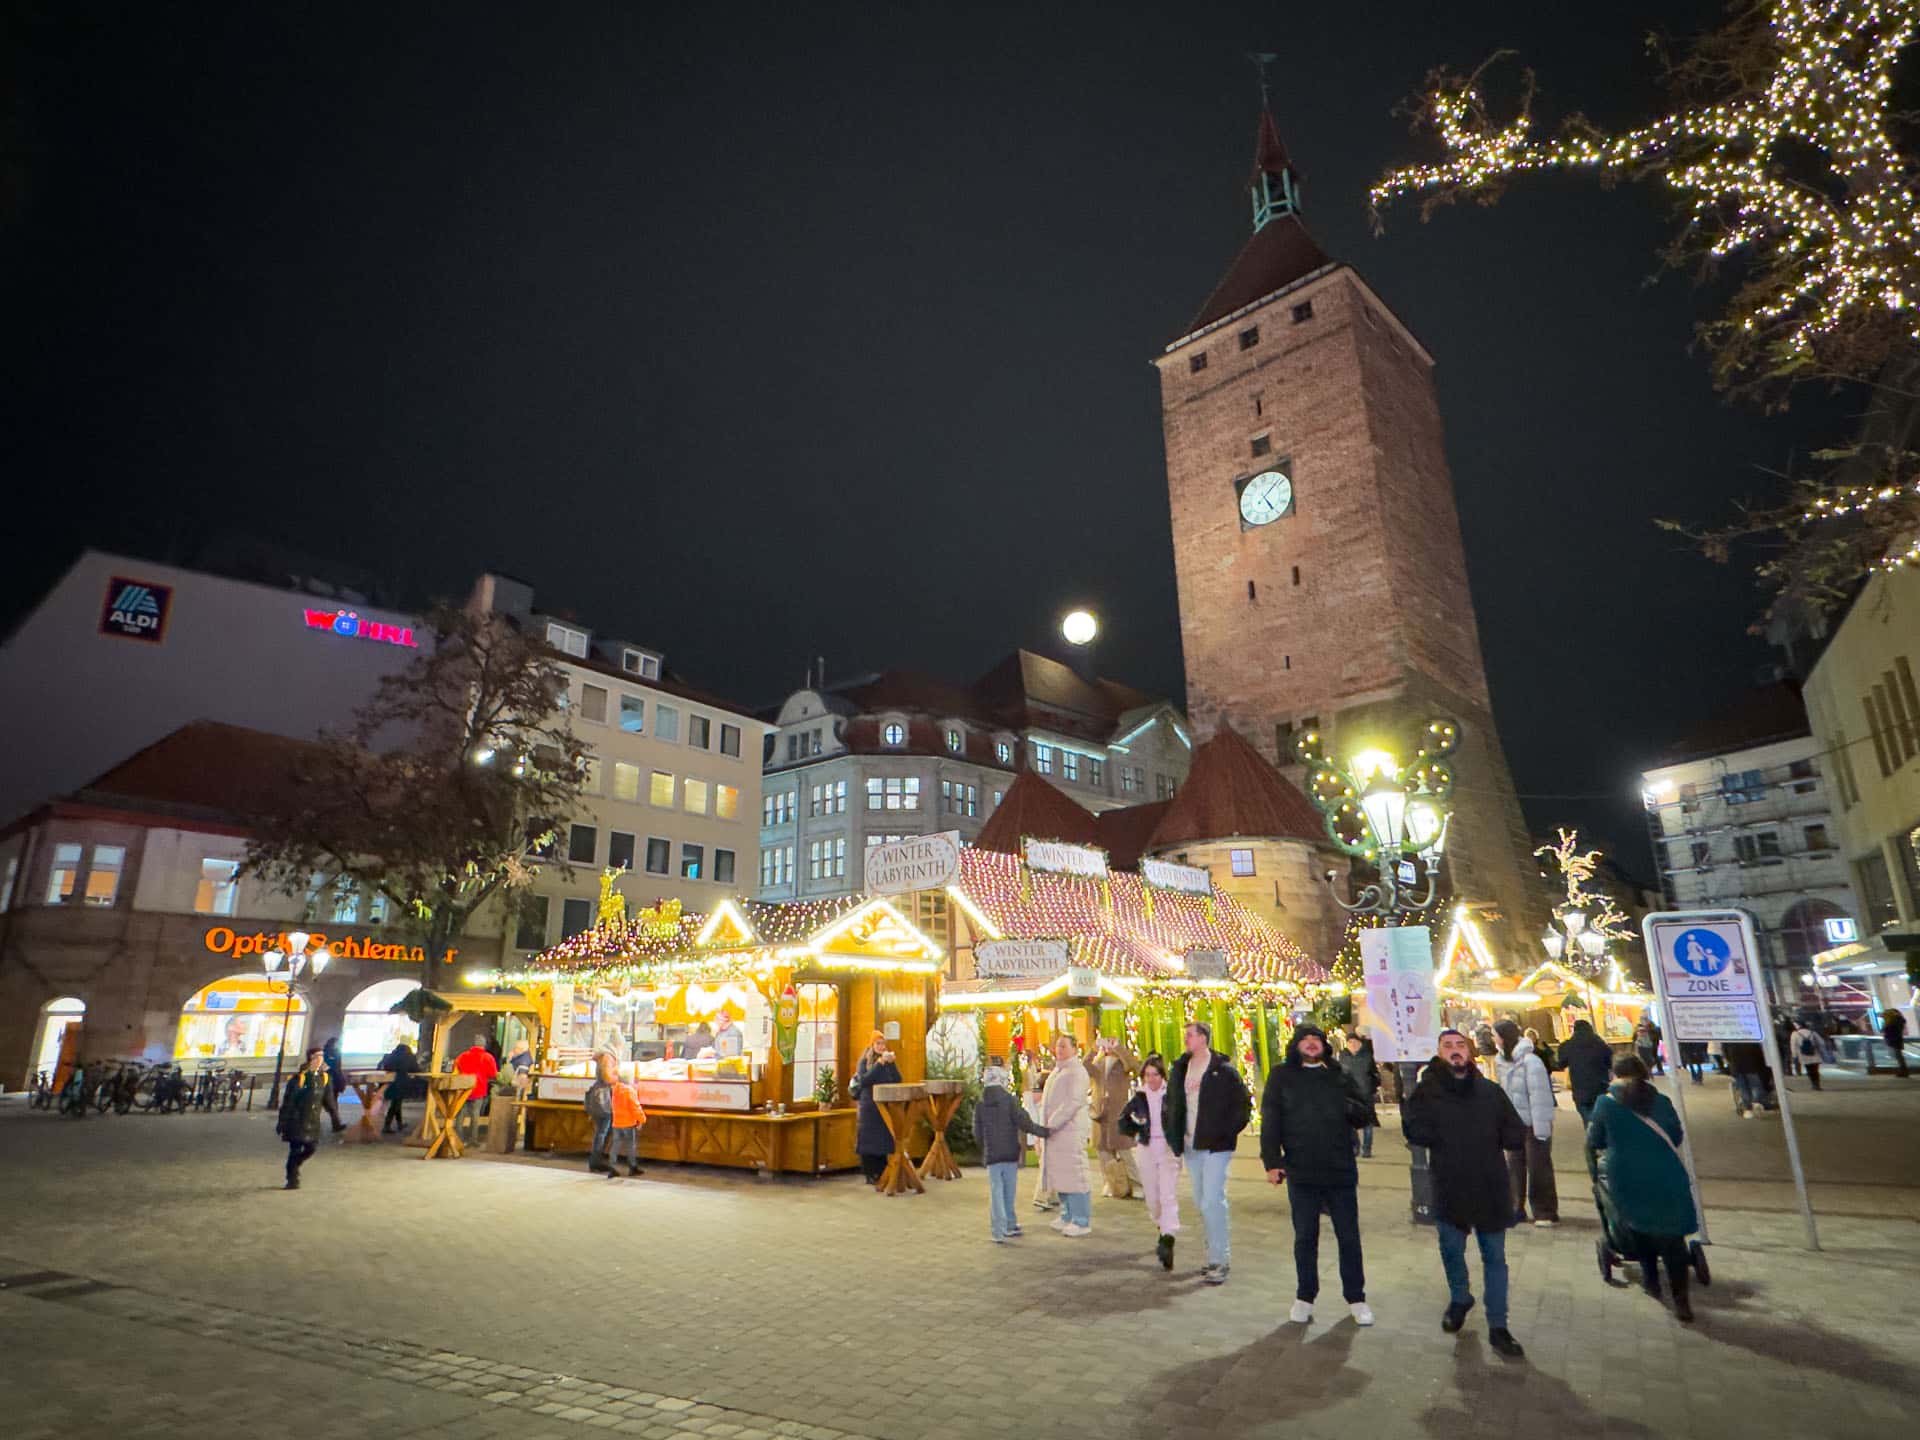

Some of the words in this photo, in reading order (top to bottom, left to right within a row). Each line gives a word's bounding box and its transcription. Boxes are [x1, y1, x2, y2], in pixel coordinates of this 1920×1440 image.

[110, 611, 158, 629] ALDI
[304, 608, 418, 647] WÖHRL
[875, 860, 945, 885] LABYRINTH
[1831, 920, 1853, 939] U
[304, 933, 460, 964] Schlemmr
[988, 959, 1059, 970] LABYRINTH
[1687, 980, 1730, 992] ZONE
